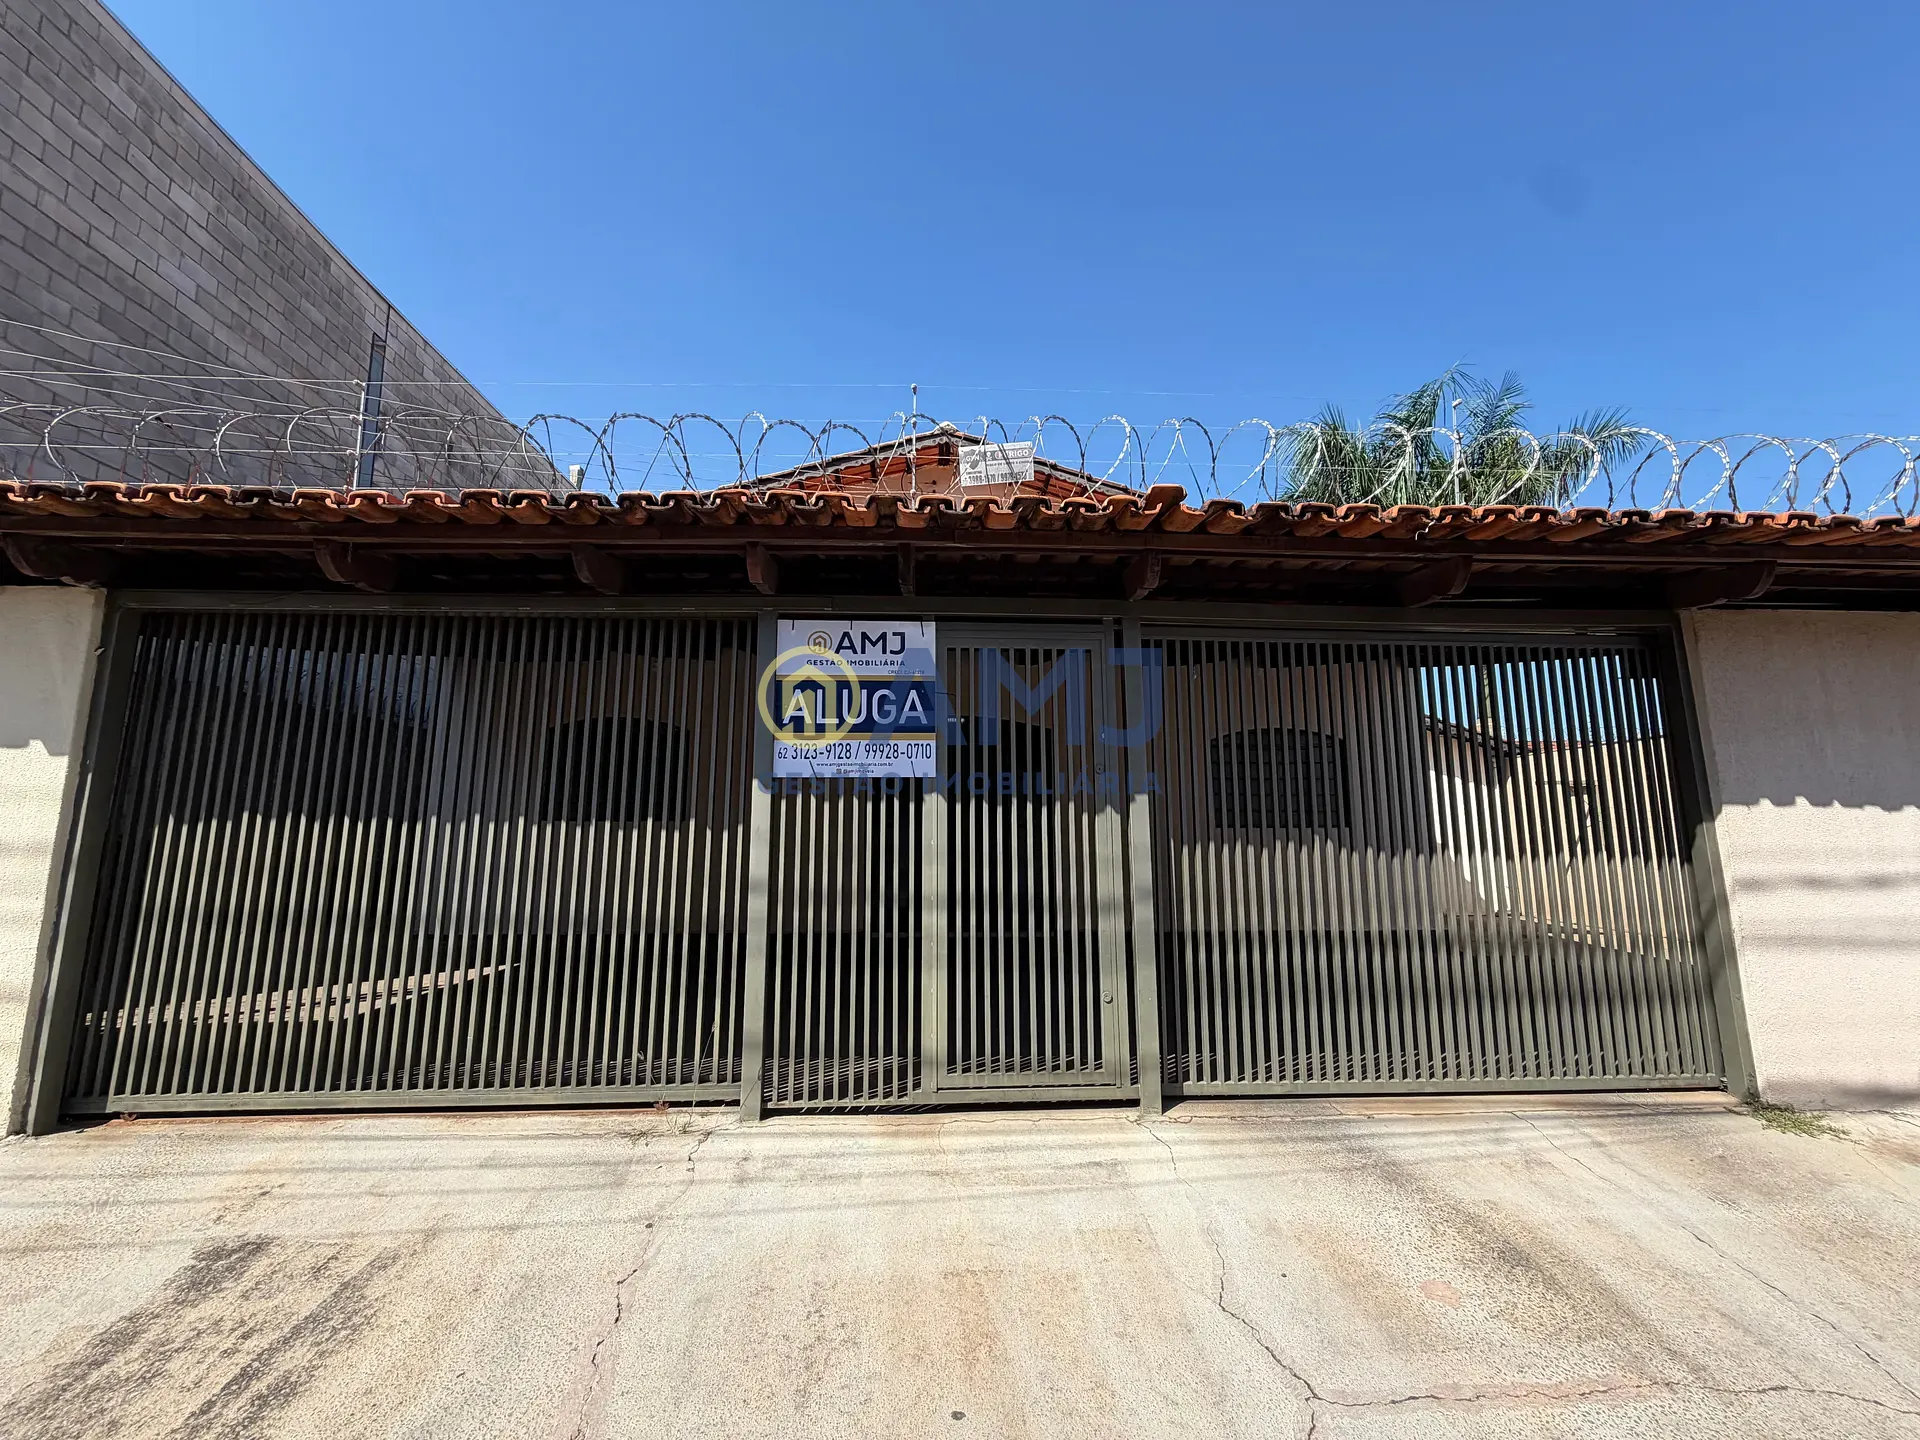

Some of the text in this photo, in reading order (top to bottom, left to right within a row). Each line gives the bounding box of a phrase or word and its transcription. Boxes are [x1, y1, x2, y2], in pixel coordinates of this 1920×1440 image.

[834, 631, 906, 655] AMJ
[806, 657, 906, 666] GESTÃO IMOBILIÁRIA
[782, 688, 928, 725] ALUGA
[777, 747, 788, 760] 62
[791, 743, 852, 760] 3123-9128
[864, 742, 932, 760] 99928-0710
